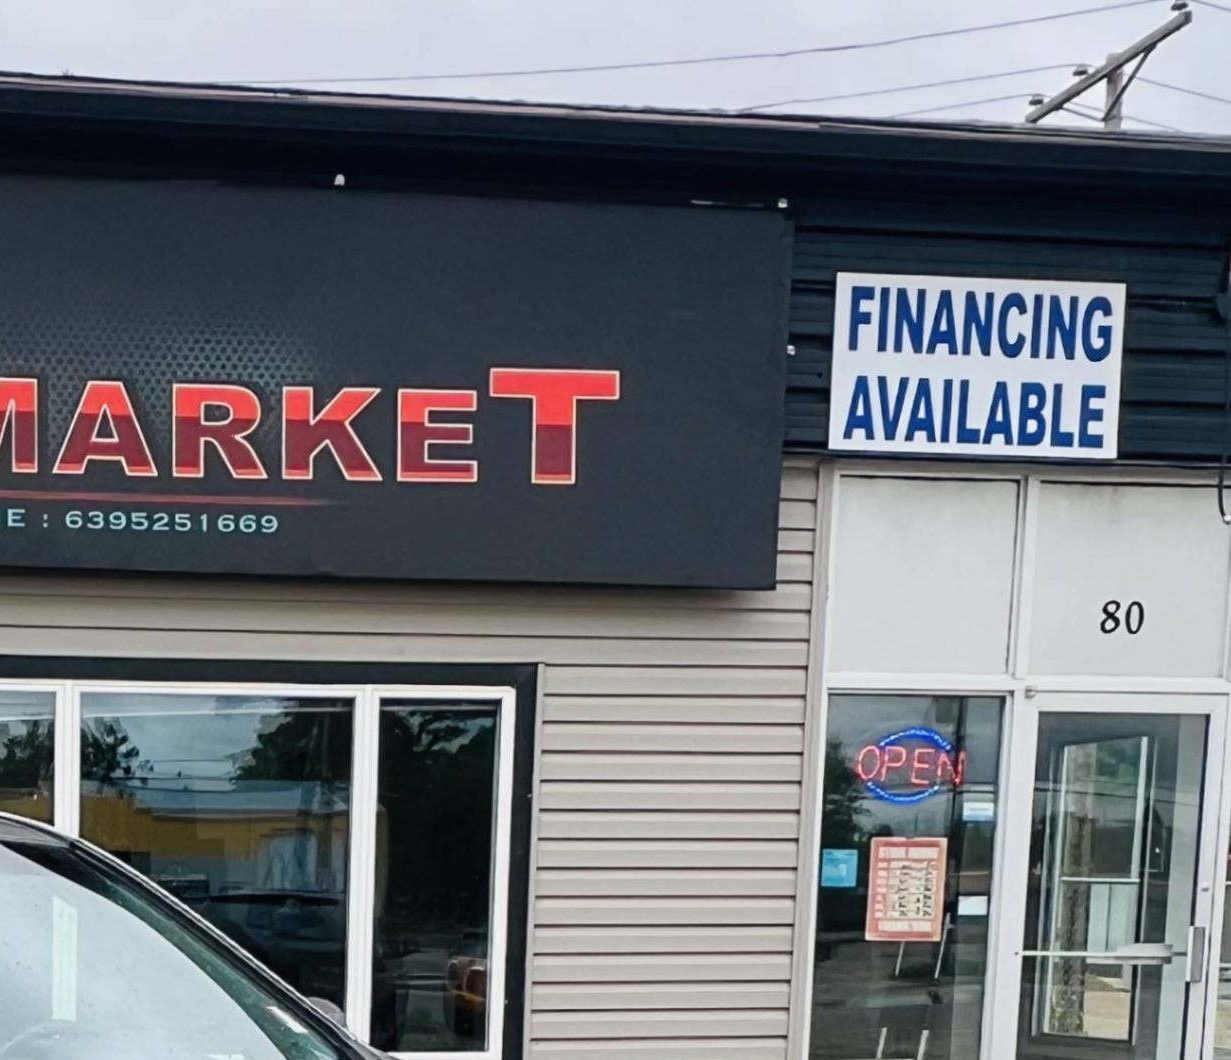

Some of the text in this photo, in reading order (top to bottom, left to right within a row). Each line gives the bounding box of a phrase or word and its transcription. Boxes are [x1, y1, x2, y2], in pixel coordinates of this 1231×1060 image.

[848, 285, 1114, 363] FINANCING
[842, 375, 1107, 449] AVAILABLE
[64, 510, 280, 533] 6395251669
[1099, 599, 1145, 635] 80
[856, 744, 968, 786] OPEN
